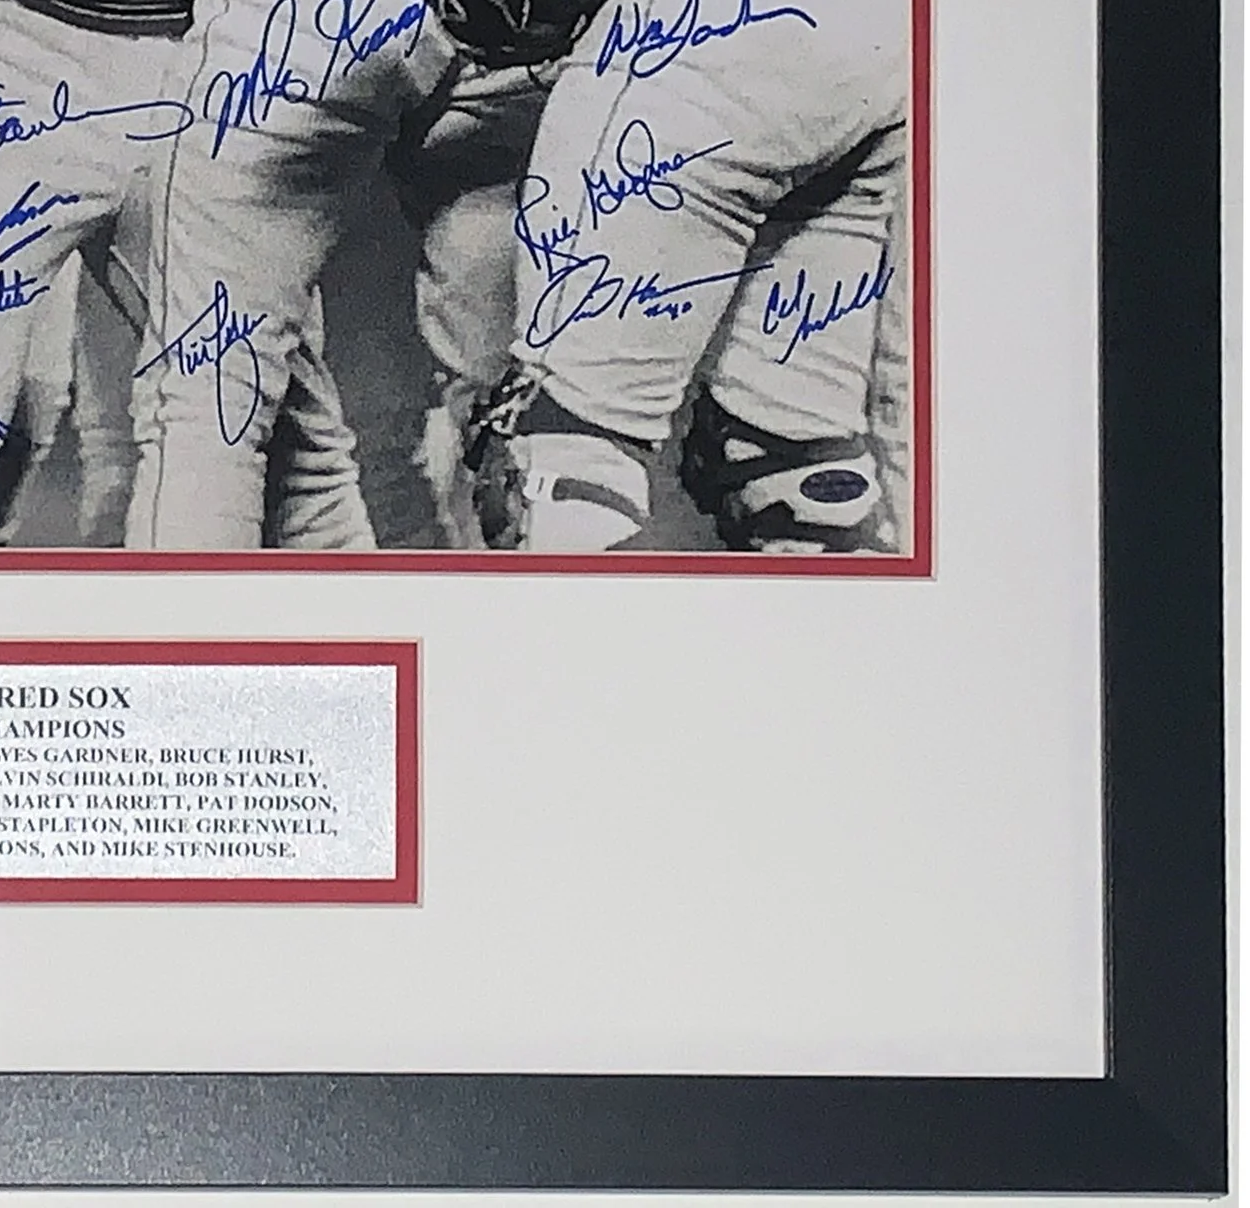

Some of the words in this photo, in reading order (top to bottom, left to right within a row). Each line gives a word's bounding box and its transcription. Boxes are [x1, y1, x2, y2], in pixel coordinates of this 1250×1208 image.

[68, 686, 130, 708] SOX
[160, 746, 230, 763] BRUCE
[175, 770, 217, 788] BOB
[2, 792, 79, 810] MARTY
[198, 793, 238, 811] PAT
[133, 816, 189, 833] MIKE
[51, 839, 96, 857] AND
[100, 839, 159, 857] MIKE
